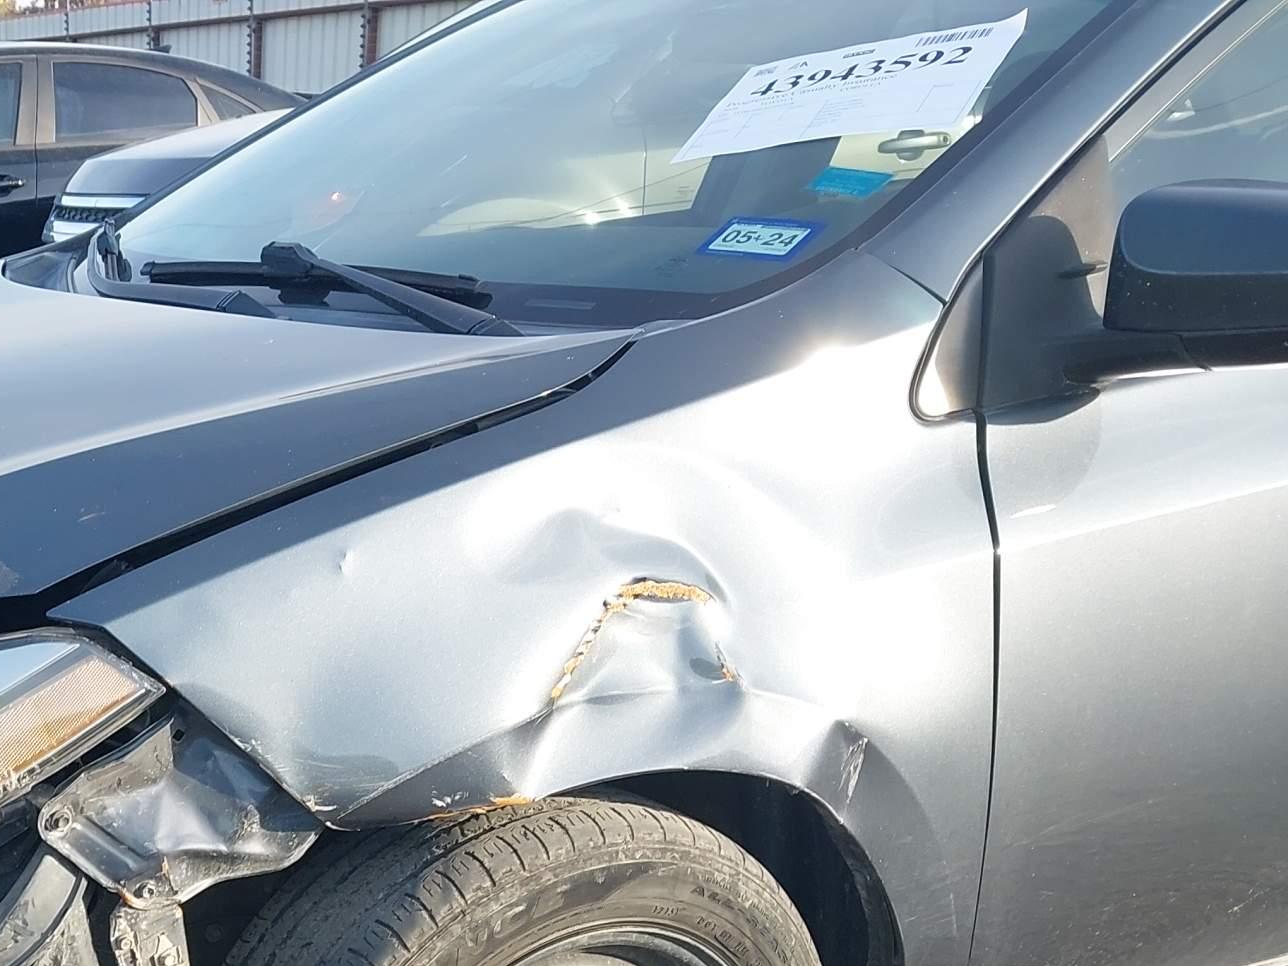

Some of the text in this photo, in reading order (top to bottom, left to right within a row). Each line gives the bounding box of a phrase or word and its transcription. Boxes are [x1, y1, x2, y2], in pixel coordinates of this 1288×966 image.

[750, 47, 973, 97] 43943592
[721, 230, 801, 248] 05 24
